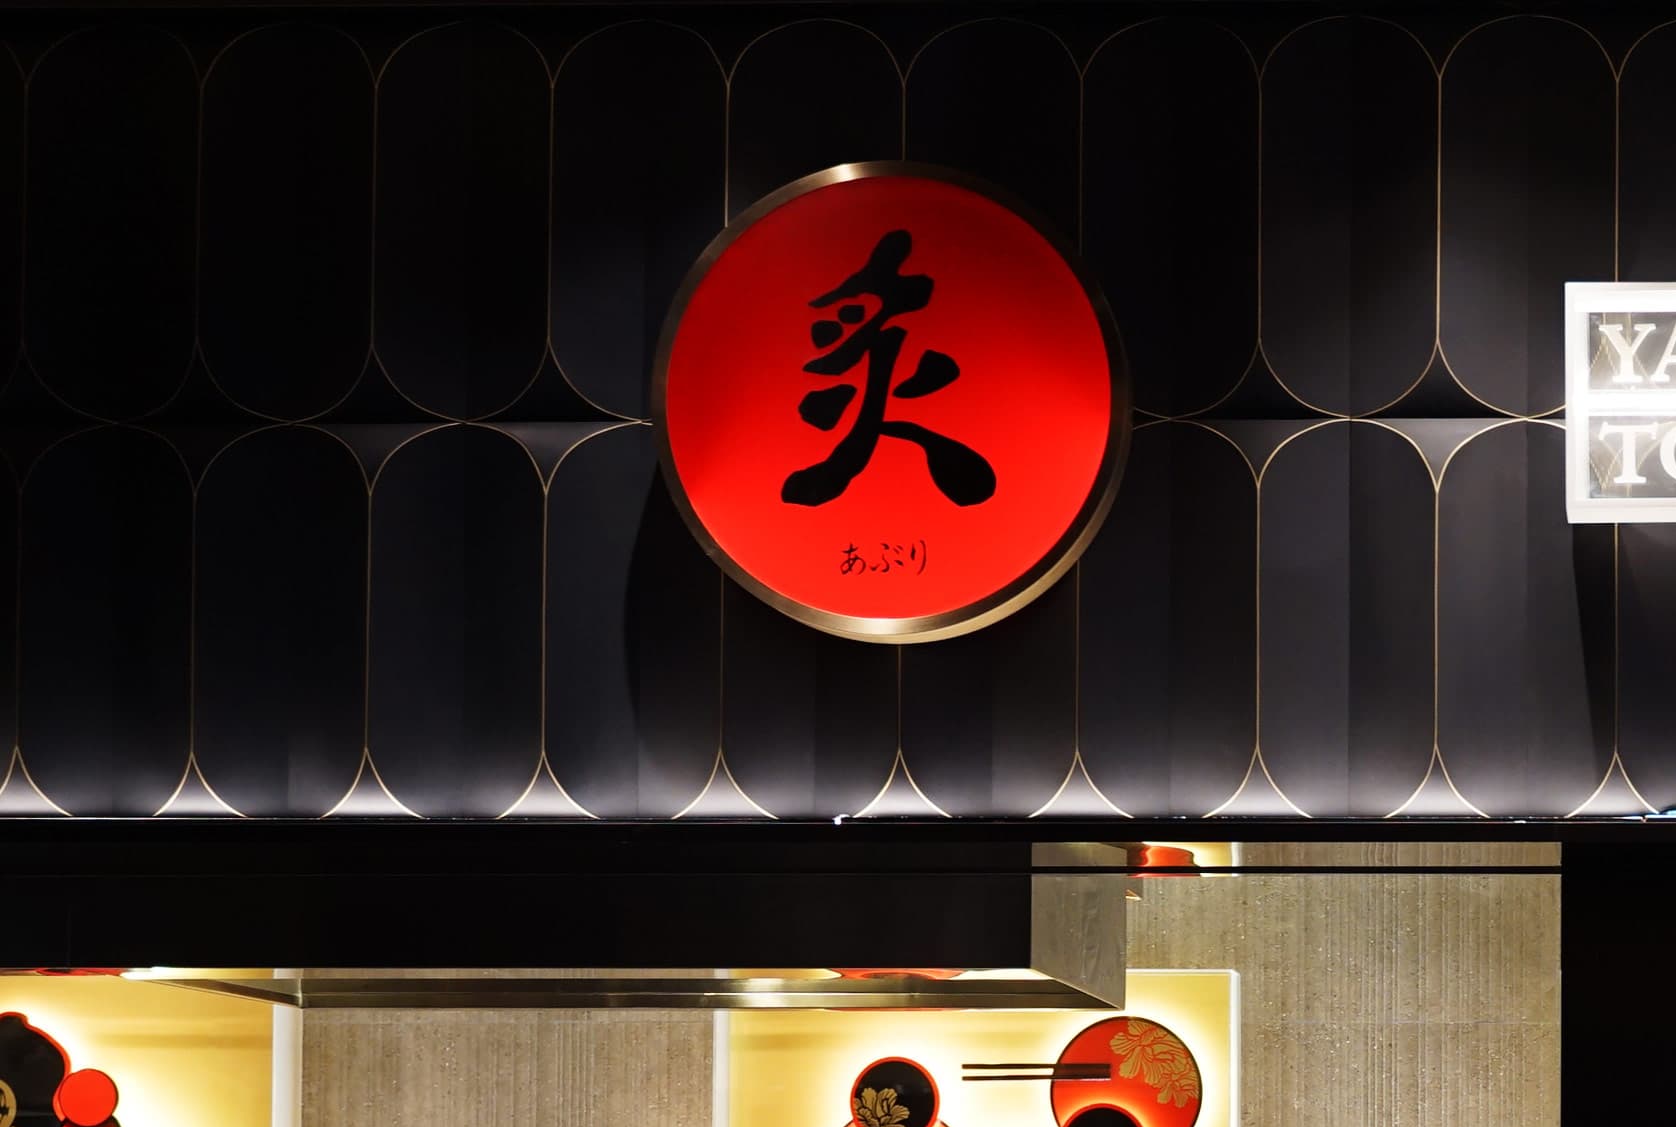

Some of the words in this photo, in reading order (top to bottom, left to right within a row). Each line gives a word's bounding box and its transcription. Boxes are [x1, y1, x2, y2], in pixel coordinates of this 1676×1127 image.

[781, 229, 997, 506] 炙
[840, 540, 927, 575] あぶり
